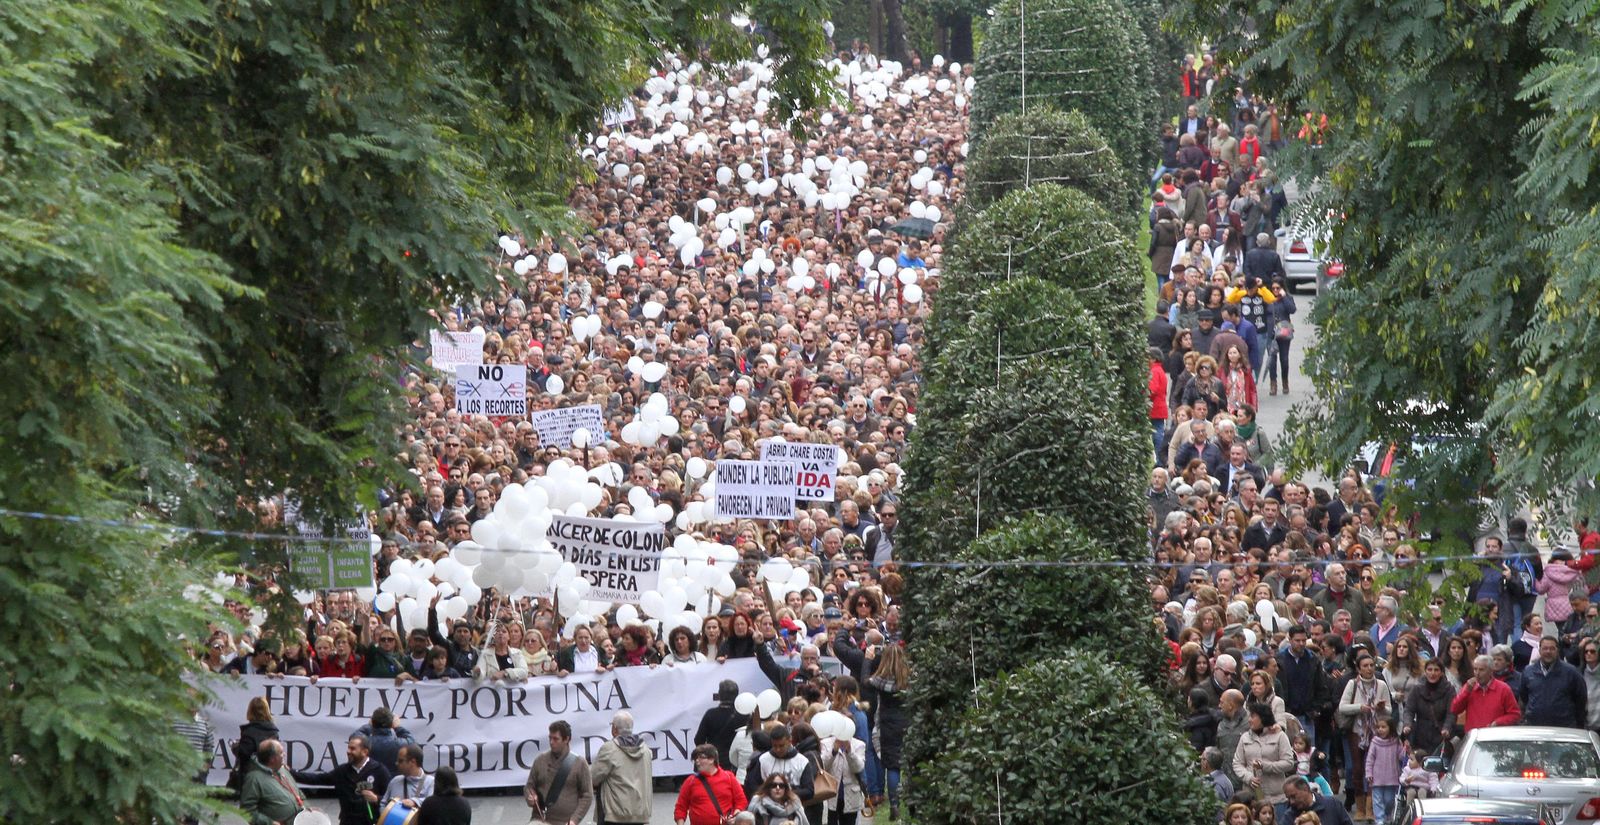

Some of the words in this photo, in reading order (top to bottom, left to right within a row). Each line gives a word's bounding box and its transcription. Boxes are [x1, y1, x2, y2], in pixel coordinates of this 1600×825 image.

[478, 366, 504, 381] NO
[457, 400, 462, 414] A
[466, 400, 481, 414] LOS
[485, 400, 525, 414] RECORTES
[536, 411, 556, 423] LISTA
[789, 445, 810, 459] CHARE
[812, 447, 836, 460] COSTA!
[801, 462, 820, 471] VA
[717, 464, 747, 485] HUNDEN
[750, 466, 760, 485] LA
[763, 465, 794, 486] PUBLICA
[796, 472, 831, 488] IDA
[797, 488, 825, 497] LLO
[717, 494, 753, 515] FAVORECEN
[755, 496, 763, 515] LA
[765, 496, 792, 516] PRIVADA
[593, 528, 611, 546] DE
[612, 529, 664, 553] COLON
[571, 544, 602, 566] DÍAS
[608, 552, 627, 571] EN
[449, 685, 532, 720] POR
[542, 677, 632, 715] UNA
